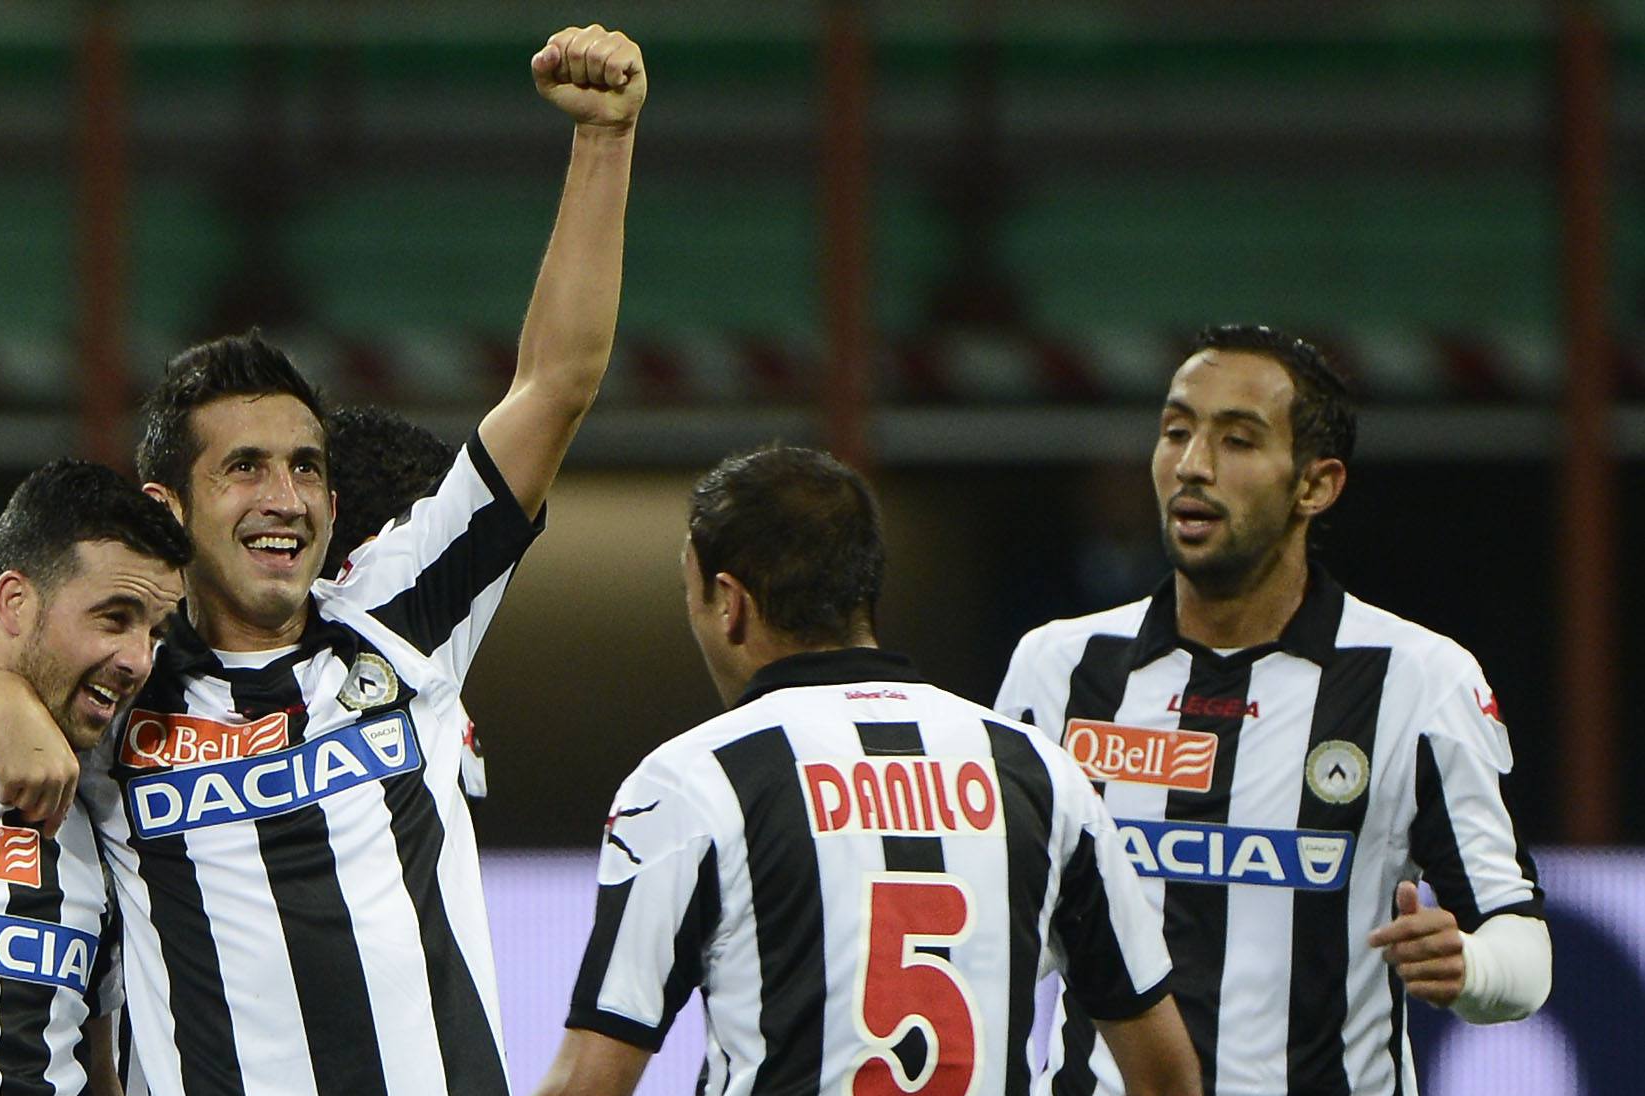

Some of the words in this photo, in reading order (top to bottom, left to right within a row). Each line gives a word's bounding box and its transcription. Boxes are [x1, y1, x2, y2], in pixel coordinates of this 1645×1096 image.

[1167, 693, 1259, 719] LEGEA
[129, 719, 241, 767] Q.Bell
[1067, 728, 1164, 780] Q.Bell
[134, 740, 369, 830] DACIA
[804, 761, 996, 832] DANILO
[1117, 826, 1286, 880] ACIA
